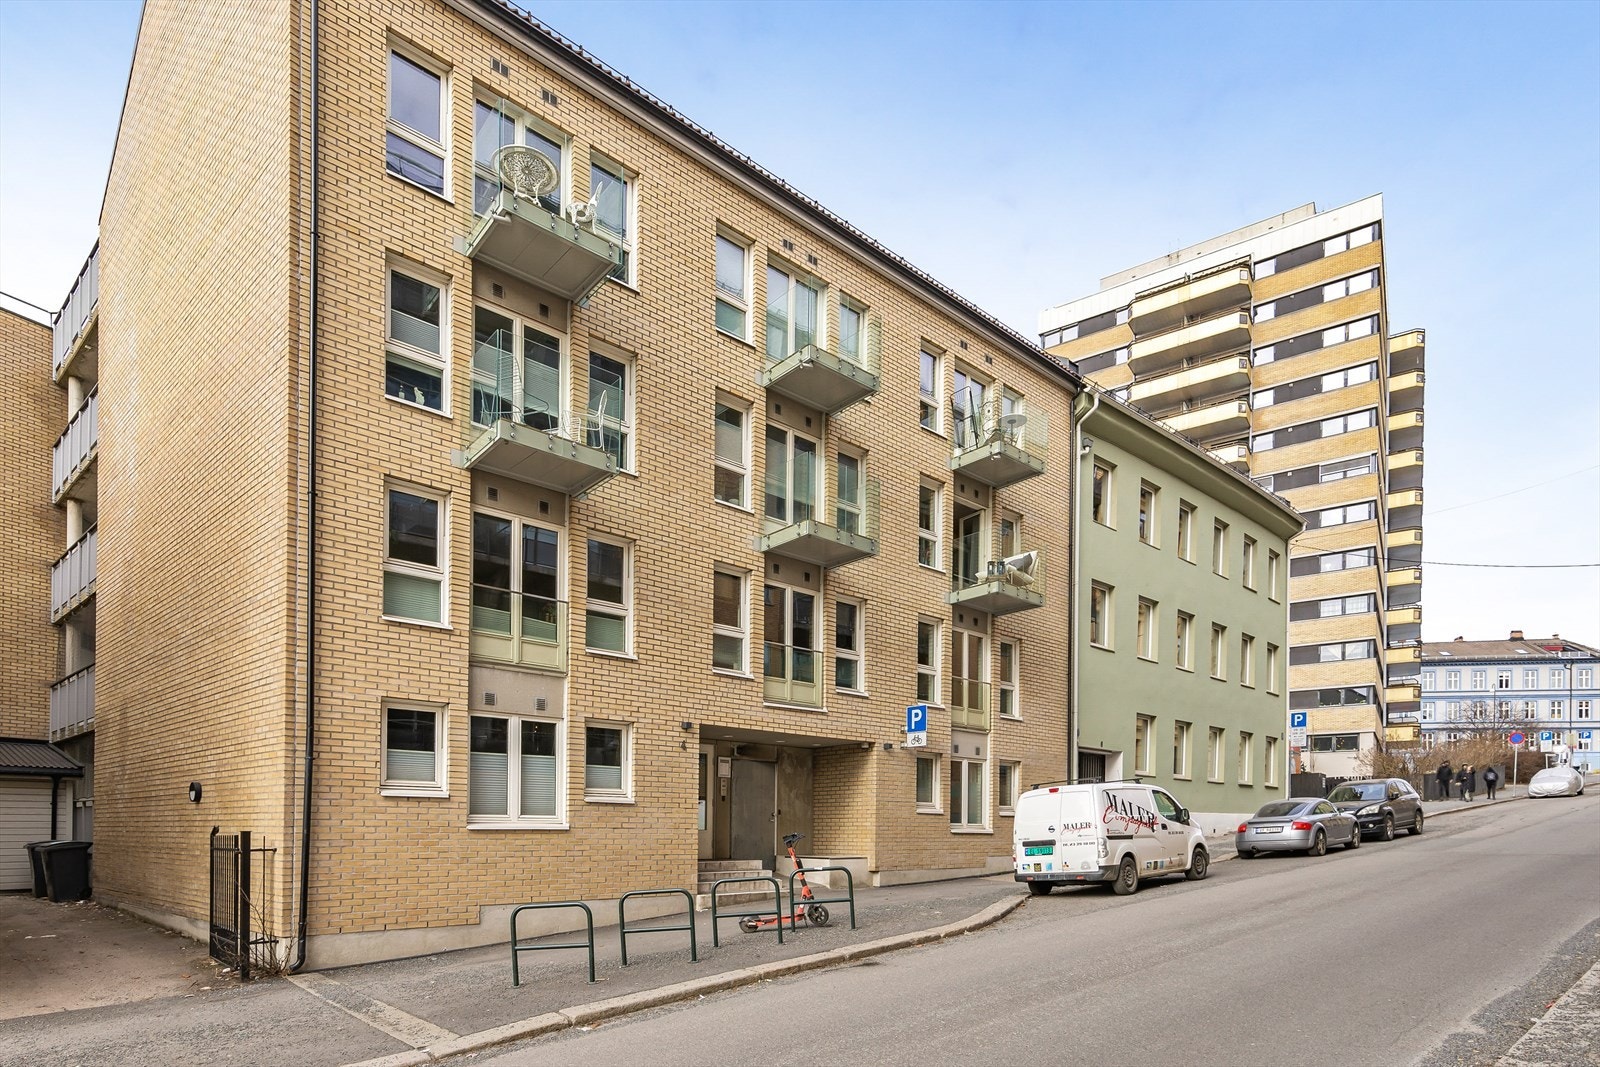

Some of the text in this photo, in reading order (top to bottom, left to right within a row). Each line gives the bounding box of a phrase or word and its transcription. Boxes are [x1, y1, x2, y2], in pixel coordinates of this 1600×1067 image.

[911, 709, 922, 729] P
[1294, 714, 1303, 726] P
[1542, 732, 1549, 740] P
[1104, 791, 1156, 833] MALER
[1063, 822, 1091, 830] MALER
